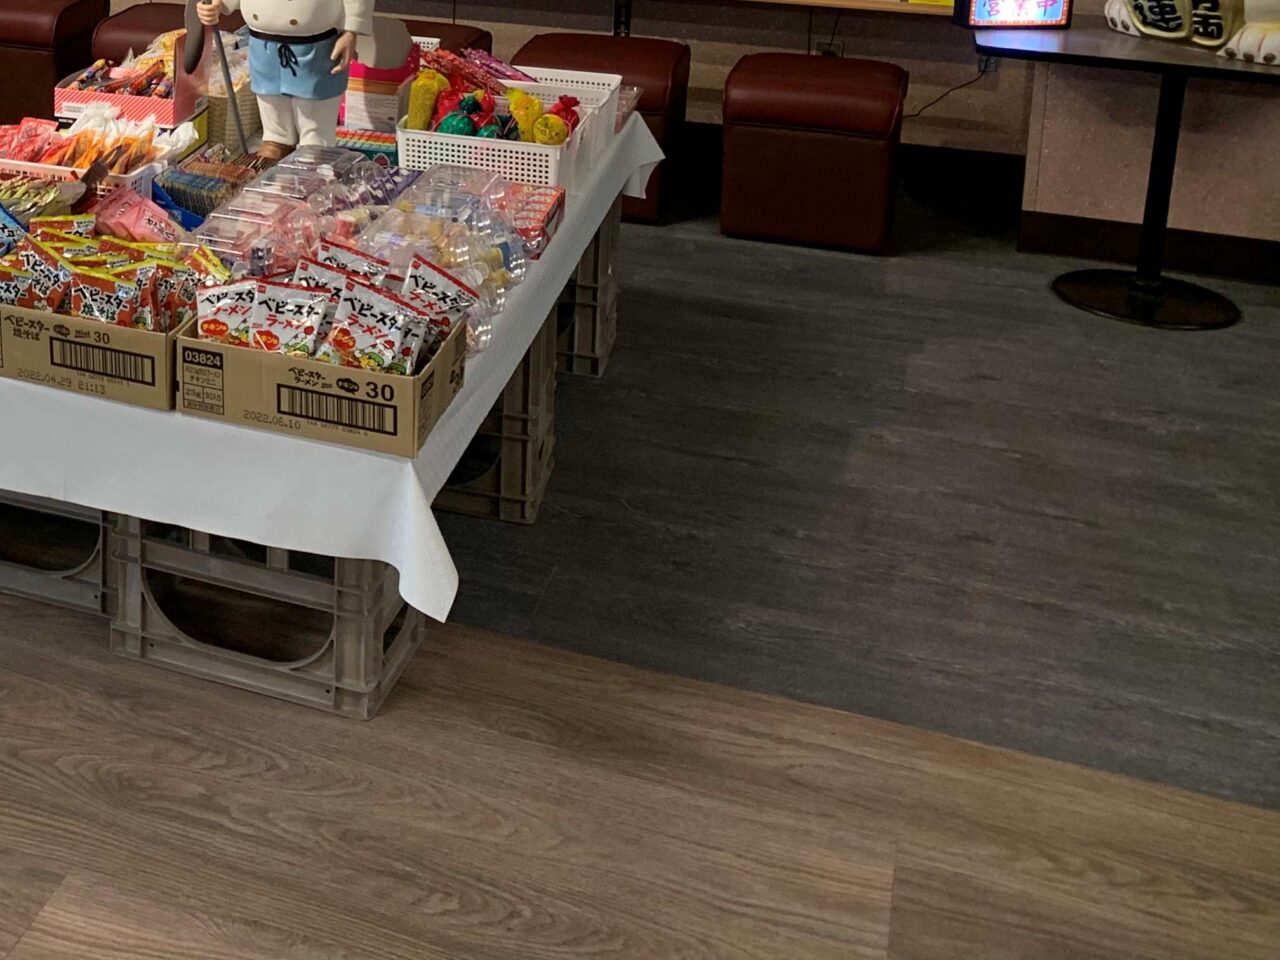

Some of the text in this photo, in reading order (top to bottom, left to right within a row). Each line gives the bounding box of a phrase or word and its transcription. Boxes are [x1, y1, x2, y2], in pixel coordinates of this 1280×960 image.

[74, 285, 129, 309] ベビースター
[258, 297, 320, 316] ベビースター
[344, 296, 402, 331] ベビースター
[4, 314, 50, 333] ベビースター
[94, 331, 110, 345] 30
[347, 313, 388, 339] ラーメン
[184, 350, 221, 366] 03824
[288, 367, 326, 381] ベビースター
[77, 380, 106, 395] 21:13
[366, 382, 394, 402] 30
